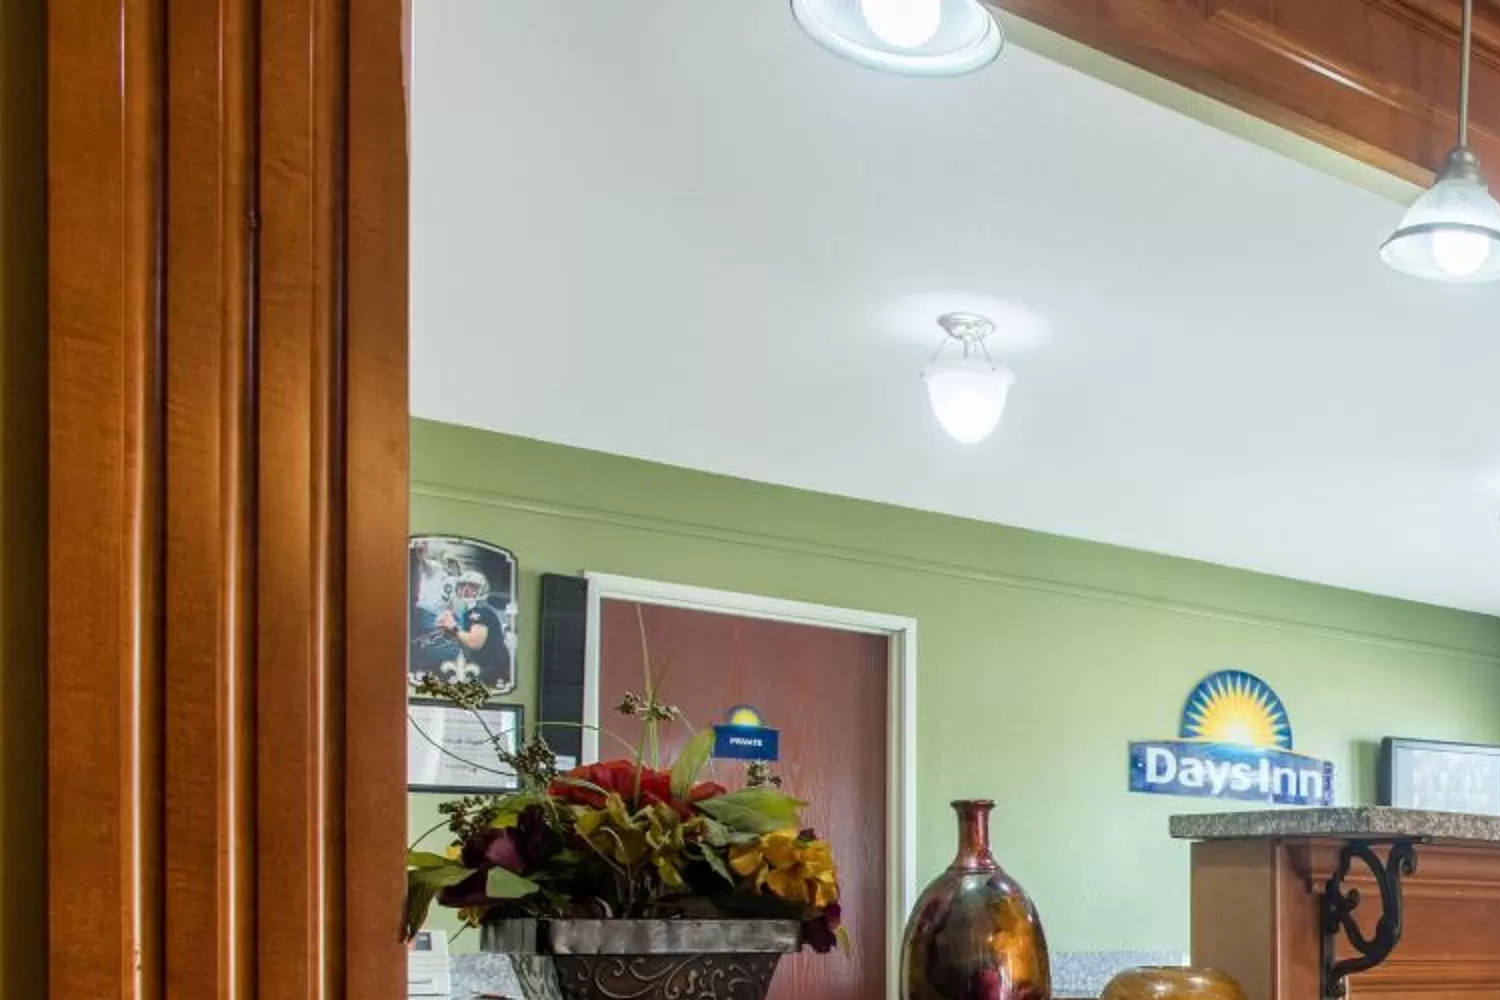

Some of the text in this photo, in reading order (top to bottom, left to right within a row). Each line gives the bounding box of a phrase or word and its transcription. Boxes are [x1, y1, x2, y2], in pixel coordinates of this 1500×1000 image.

[729, 736, 763, 747] PRIVATE
[1145, 747, 1323, 797] Days Inn
